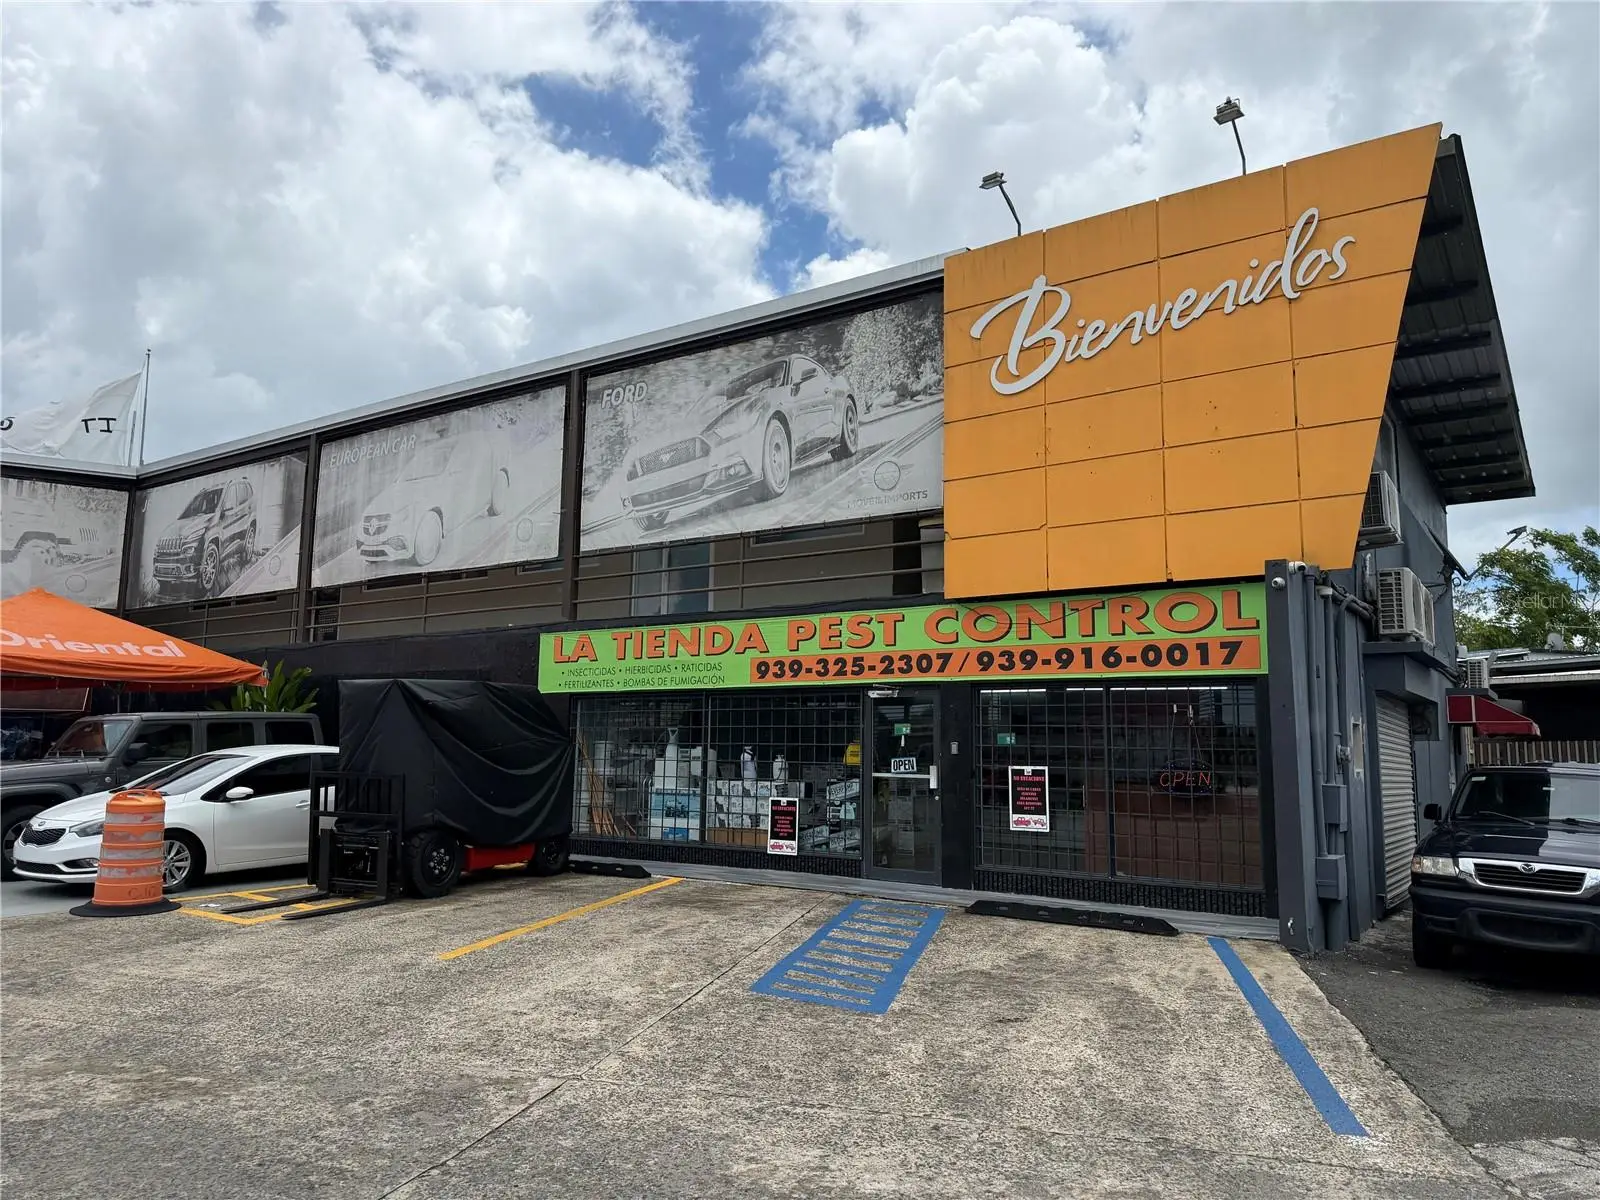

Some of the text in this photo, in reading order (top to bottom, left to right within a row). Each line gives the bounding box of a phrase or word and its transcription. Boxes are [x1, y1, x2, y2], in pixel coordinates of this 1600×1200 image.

[969, 207, 1356, 395] Bienvenidos
[601, 381, 648, 409] FORD
[329, 434, 417, 468] EUROPEAN CAR
[553, 588, 1261, 664] LA TIENDA PEST CONTROL
[0, 628, 187, 658] Oriental
[564, 674, 725, 689] FERTILIZANTES BOMBAS DE FUMIGACIÓN
[567, 662, 722, 677] INSECTICIDAS HIERBICIDAS RATICIDAS
[892, 759, 915, 772] OPEN
[1160, 770, 1211, 787] OPEN
